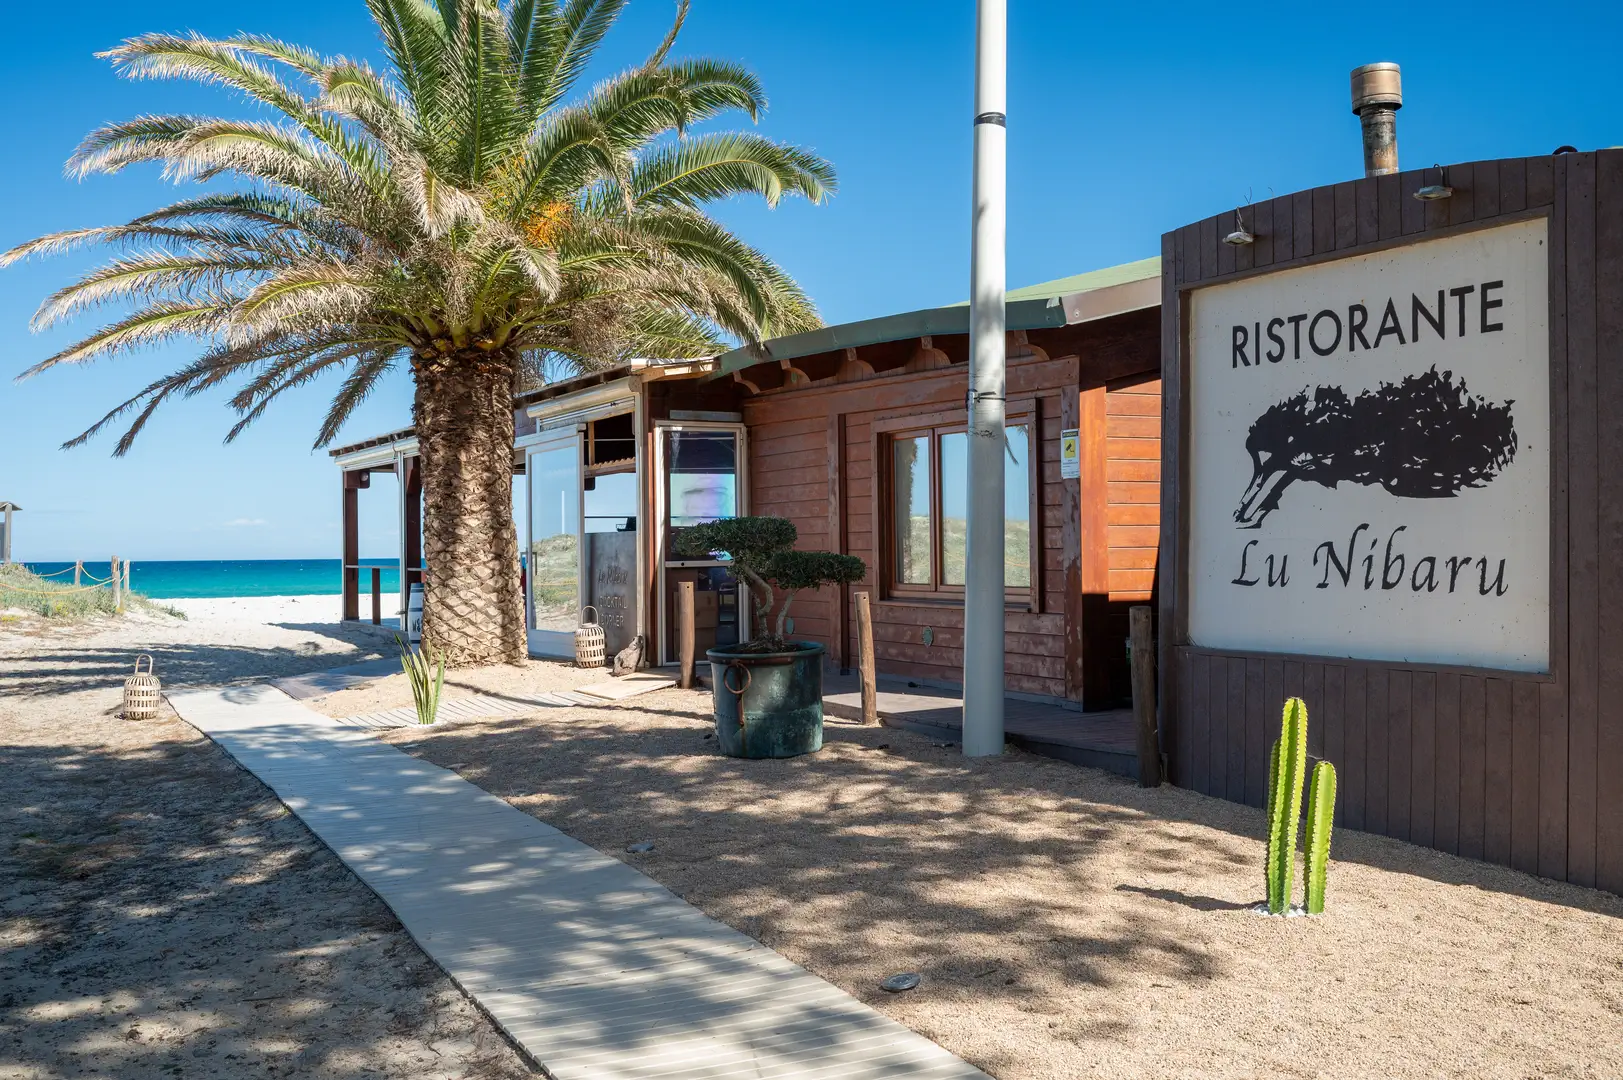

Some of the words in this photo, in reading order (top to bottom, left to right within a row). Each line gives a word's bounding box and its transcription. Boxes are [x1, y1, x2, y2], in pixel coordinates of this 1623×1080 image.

[1232, 280, 1503, 368] RISTORANTE
[1231, 540, 1290, 590] Lu
[1313, 523, 1509, 596] Nibaru
